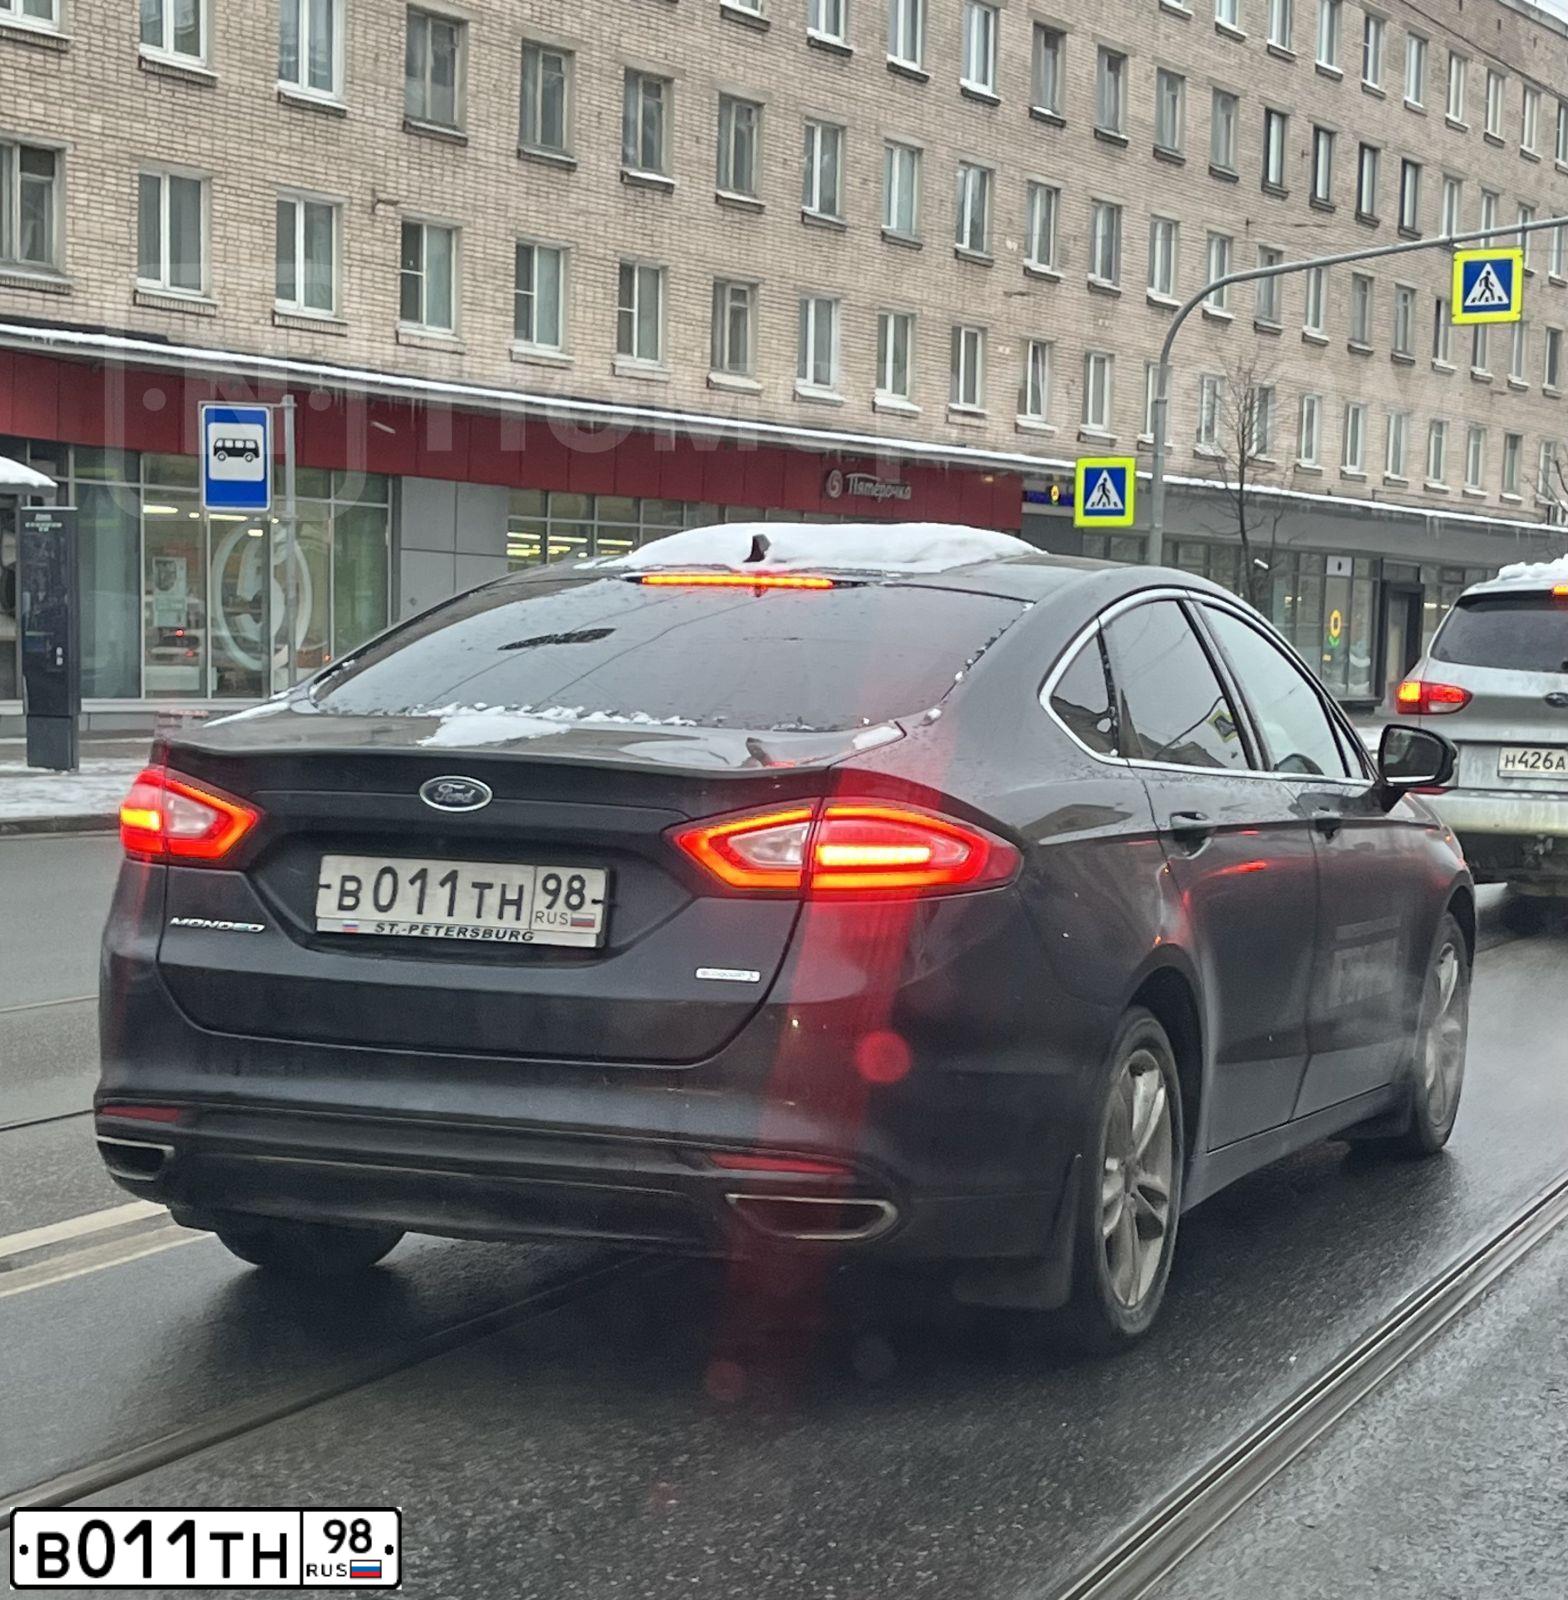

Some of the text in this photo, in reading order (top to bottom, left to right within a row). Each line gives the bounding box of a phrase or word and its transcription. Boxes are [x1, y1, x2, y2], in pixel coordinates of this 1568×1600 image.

[433, 783, 476, 803] Ford
[337, 866, 586, 922] В011ТН 98
[535, 910, 569, 925] RUS
